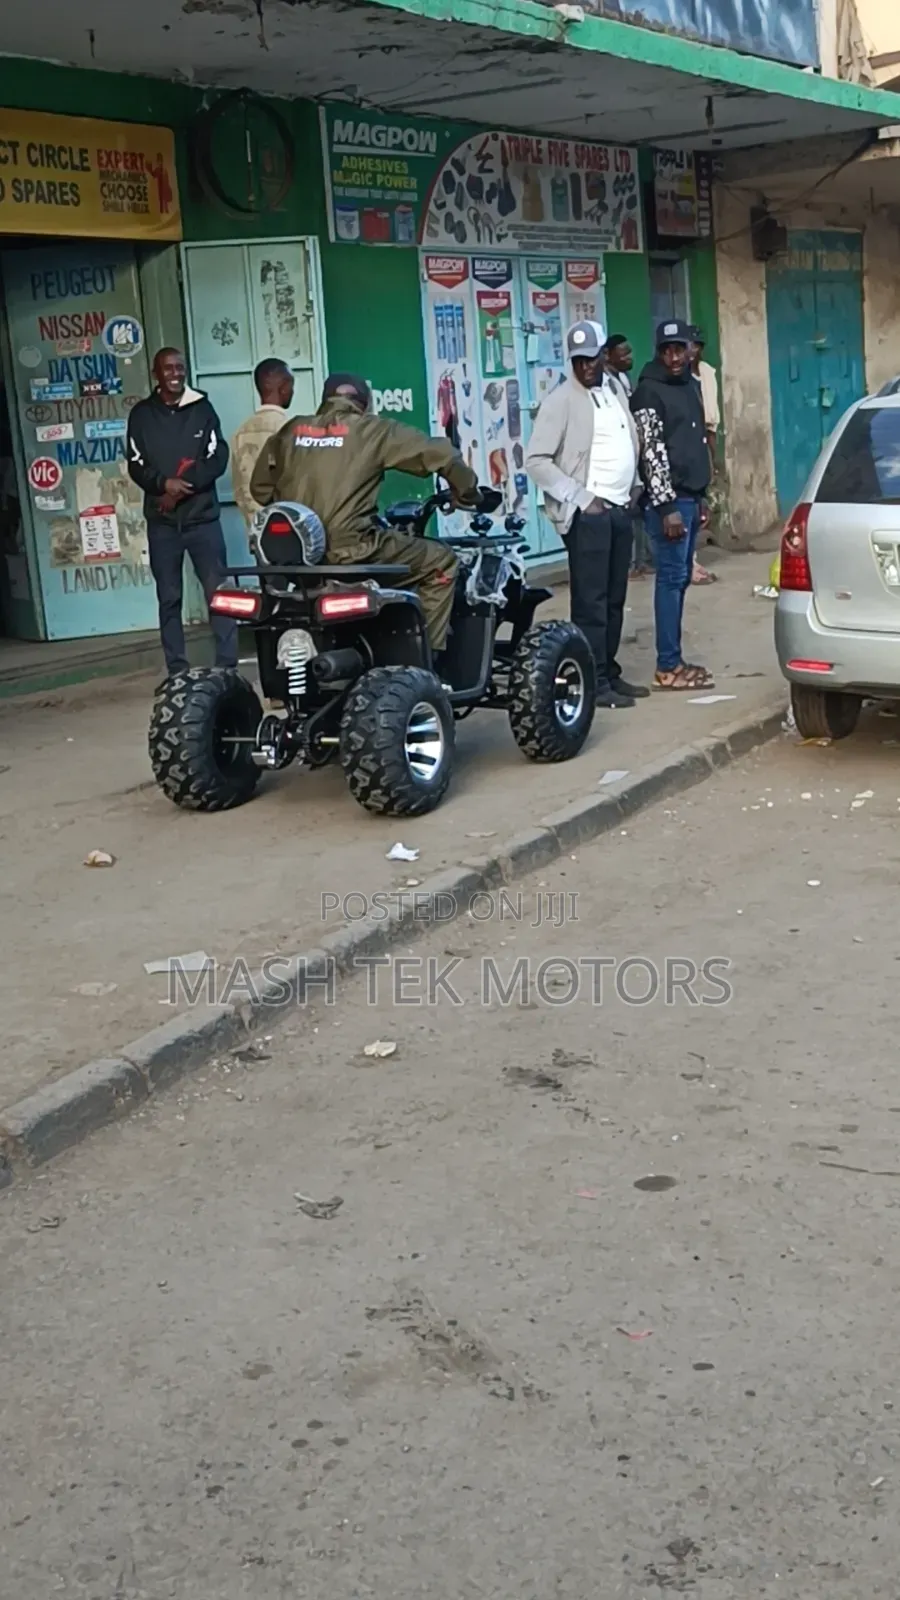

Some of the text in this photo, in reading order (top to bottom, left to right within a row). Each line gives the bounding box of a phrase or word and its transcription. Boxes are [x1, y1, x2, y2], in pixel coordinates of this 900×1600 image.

[333, 120, 437, 152] MAGPOW
[26, 142, 91, 172] CIRCLE
[97, 149, 145, 172] EXPERT
[342, 156, 408, 174] ADHESIVES
[505, 135, 631, 173] TRIPLE FIVE SPARES LTD
[11, 178, 81, 207] SPARES
[100, 182, 148, 202] CHOOSE
[377, 174, 417, 189] POWER
[31, 265, 117, 301] PEUGEOT
[38, 311, 106, 341] NISSAN
[48, 354, 117, 384] DATSUN
[54, 397, 119, 425] TOYOTA
[57, 439, 125, 466] MAZDA
[295, 437, 344, 447] MOTORS
[62, 564, 153, 594] LAND ROVE
